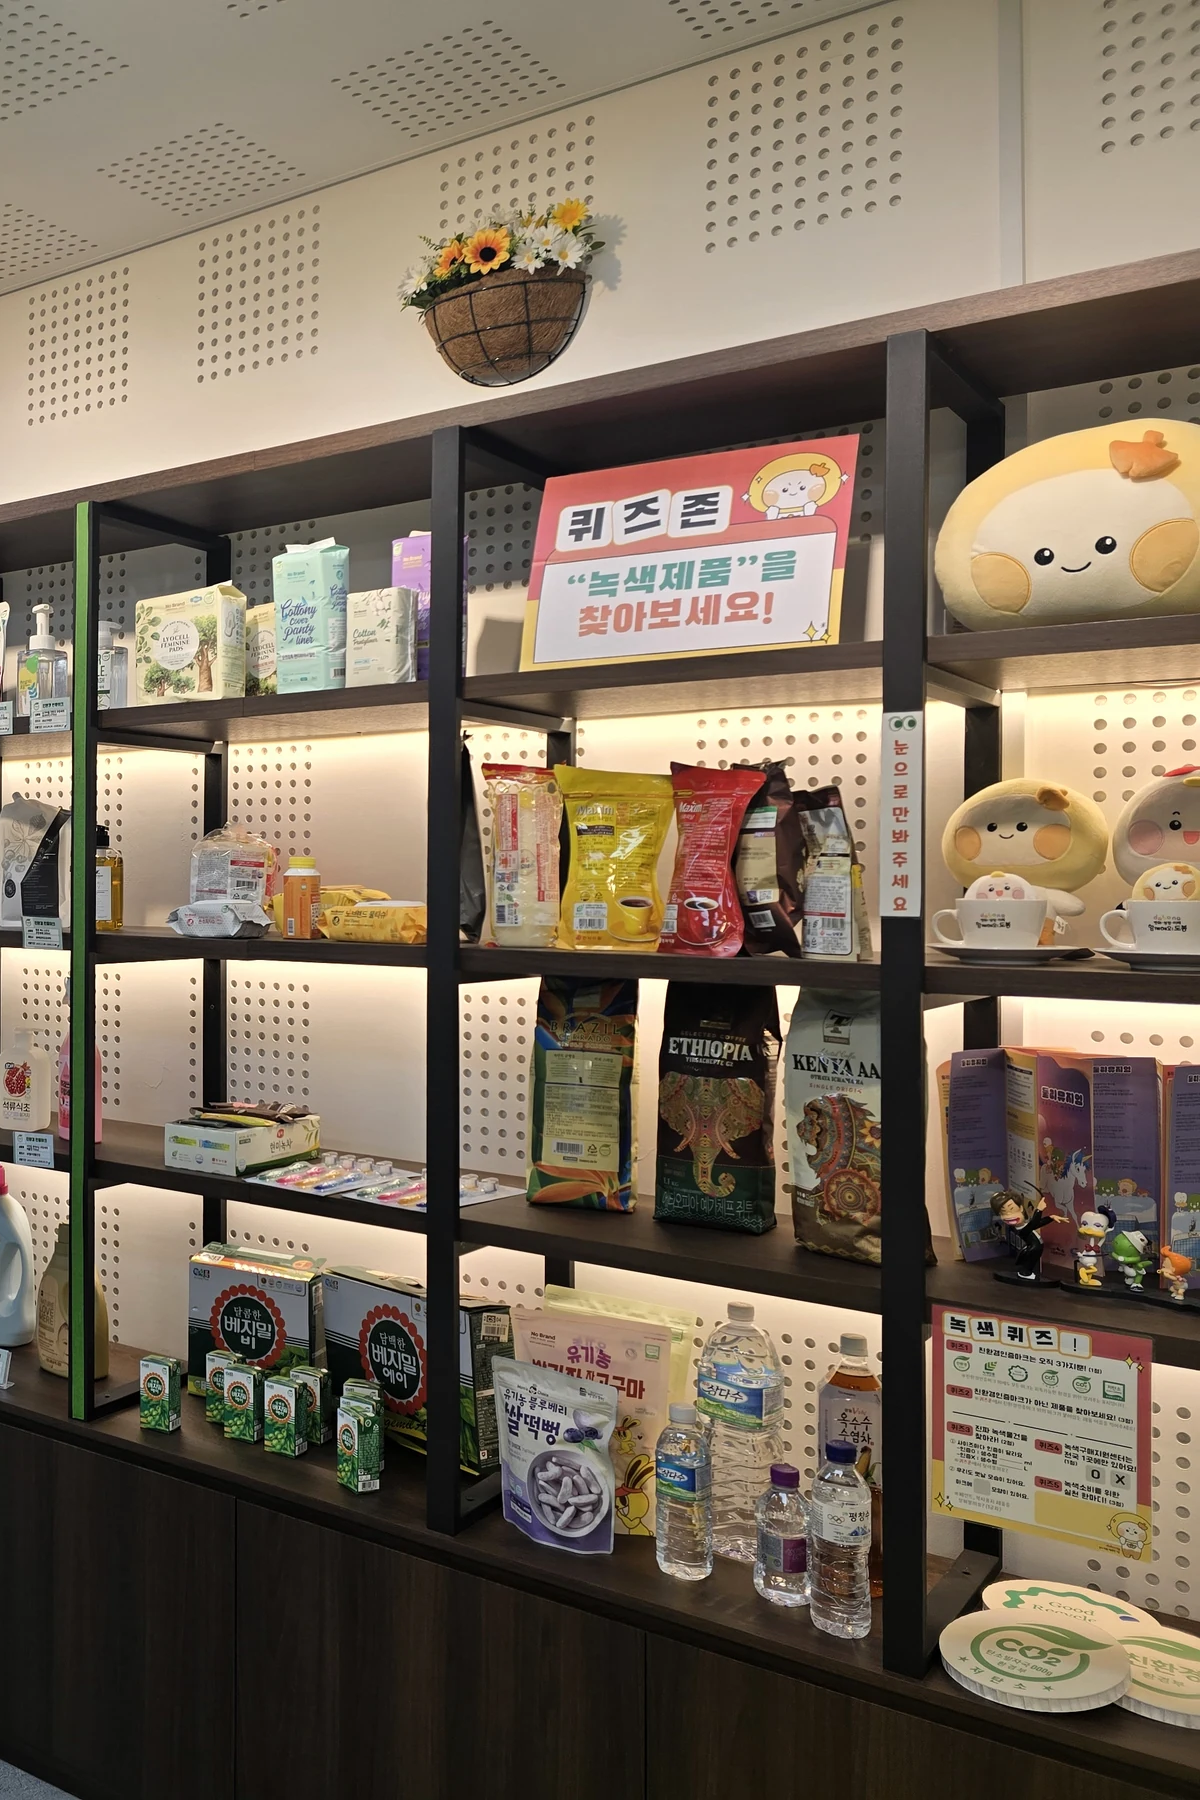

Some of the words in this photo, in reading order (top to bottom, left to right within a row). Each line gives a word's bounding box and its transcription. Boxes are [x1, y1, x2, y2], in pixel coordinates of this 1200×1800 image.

[568, 492, 720, 543] 퀴즈존
[281, 599, 317, 619] Cottony
[578, 591, 775, 637] 찾아보세요!
[161, 640, 190, 649] FEMININE
[162, 634, 190, 643] LYOCELL
[576, 805, 614, 816] Maxim
[679, 801, 702, 813] Maxim
[345, 910, 368, 919] 노브랜드
[550, 1022, 621, 1035] BRAZIL
[668, 1036, 753, 1061] ETHIOPIA
[792, 1053, 855, 1077] KENYA
[858, 1062, 882, 1080] AA
[809, 1083, 833, 1091] SINGLE
[1041, 1086, 1085, 1107] 둘리뮤지엄
[3, 1101, 30, 1112] 석류식초
[269, 1138, 293, 1153] 현미녹차
[233, 1306, 262, 1321] 달콤한
[224, 1315, 271, 1340] 베지밀
[240, 1335, 256, 1349] 비
[379, 1332, 406, 1352] 담백한
[539, 1333, 556, 1341] Brand
[370, 1342, 417, 1376] 베지밀
[567, 1345, 612, 1369] 유기농
[951, 1341, 968, 1350] 퀴즈1
[979, 1347, 1036, 1363] 친환경인증마크는
[1039, 1357, 1054, 1366] 오직
[382, 1367, 408, 1389] 에이
[504, 1388, 527, 1406] 유기농
[529, 1396, 567, 1415] 블루베리
[707, 1384, 745, 1403] 삼다수
[951, 1387, 970, 1397] 퀴즈2
[974, 1387, 1032, 1404] 친환경인증마크가
[1034, 1399, 1049, 1409] 아닌
[1050, 1402, 1073, 1413] 제품을
[1075, 1407, 1116, 1421] 찾아보세요!
[837, 1413, 872, 1431] 옥수수
[951, 1423, 971, 1433] 퀴즈3
[838, 1431, 872, 1444] 수염차
[1039, 1441, 1060, 1451] 퀴즈4
[1064, 1443, 1133, 1464] 녹색구매지원센터는
[1064, 1451, 1079, 1460] 전국
[1081, 1455, 1109, 1467] 1곳에만
[1111, 1461, 1137, 1472] 있어요!
[661, 1469, 686, 1481] 삼다수
[1115, 1474, 1126, 1485] X
[1039, 1479, 1060, 1489] 퀴즈5
[1064, 1480, 1102, 1495] 녹색소비를
[1104, 1490, 1120, 1499] 위한
[1064, 1489, 1079, 1498] 실천
[1081, 1492, 1107, 1504] 한마디!
[849, 1511, 869, 1522] 평창수
[1048, 1600, 1095, 1616] Good
[985, 1649, 1030, 1670] 탄소발자국
[997, 1660, 1027, 1673] 환경부
[1142, 1671, 1185, 1688] 환경부
